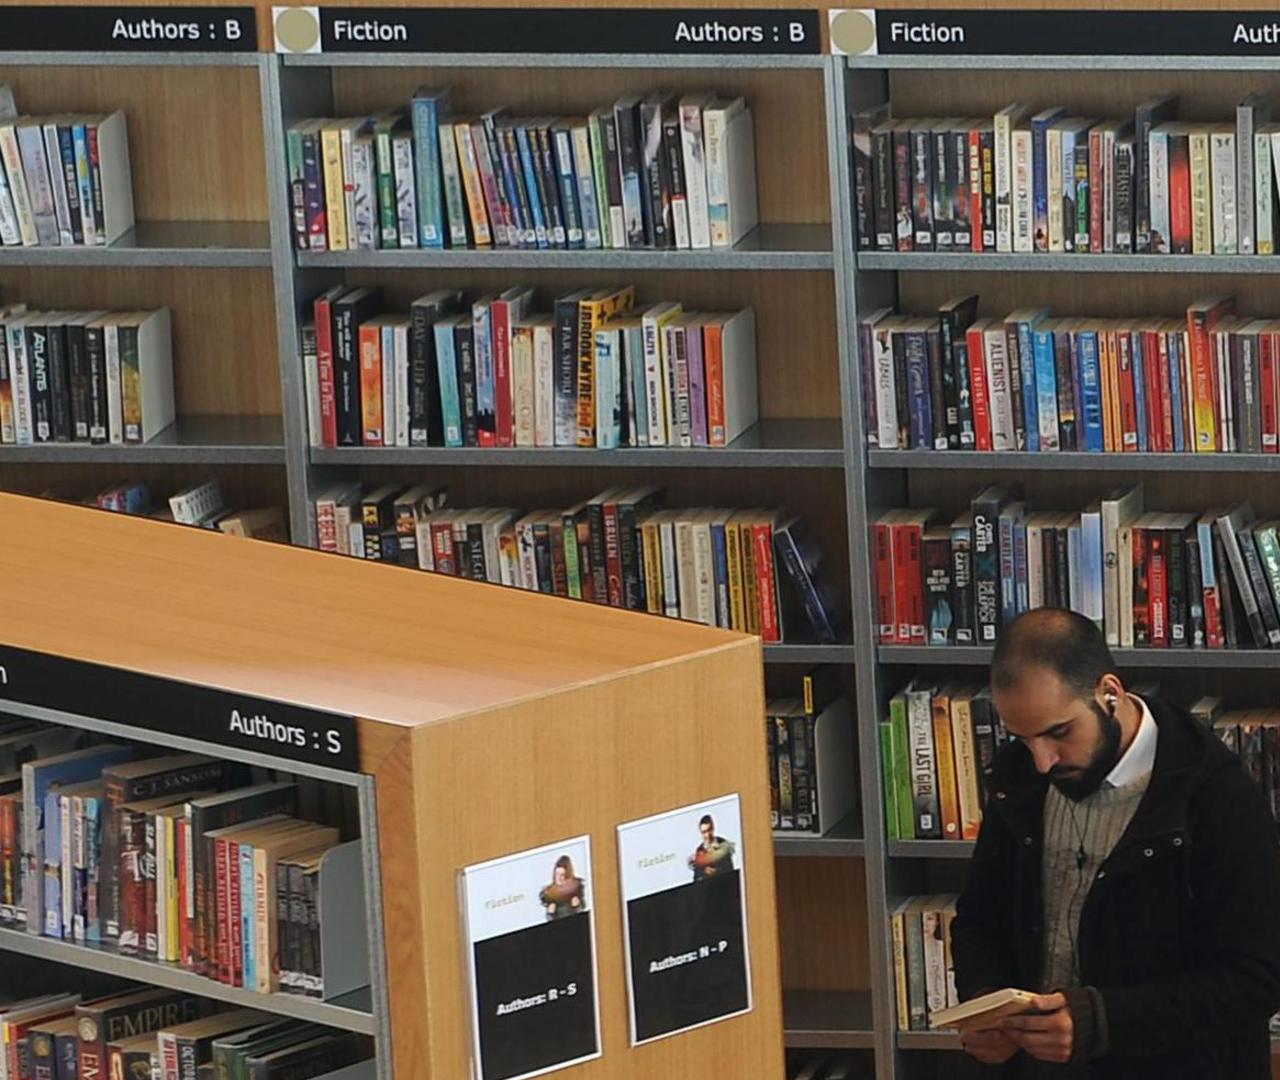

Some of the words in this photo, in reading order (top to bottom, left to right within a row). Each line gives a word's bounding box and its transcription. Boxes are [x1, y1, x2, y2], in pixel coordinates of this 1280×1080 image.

[112, 19, 200, 40] Authors
[225, 20, 241, 40] B
[333, 21, 407, 41] Fiction
[675, 22, 764, 42] Authors
[789, 23, 805, 42] B
[890, 23, 964, 43] Fiction
[33, 332, 47, 391] ATLANTIS
[990, 343, 1006, 394] ALIENIST
[975, 516, 986, 552] CARTER
[229, 710, 307, 747] Authors
[326, 729, 342, 754] S
[916, 747, 930, 773] LAST
[917, 774, 931, 797] GIRL
[649, 950, 698, 974] Authors:
[699, 945, 710, 959] N
[718, 939, 728, 953] P
[496, 993, 547, 1016] Authors:
[548, 988, 559, 1001] R
[567, 982, 578, 996] S
